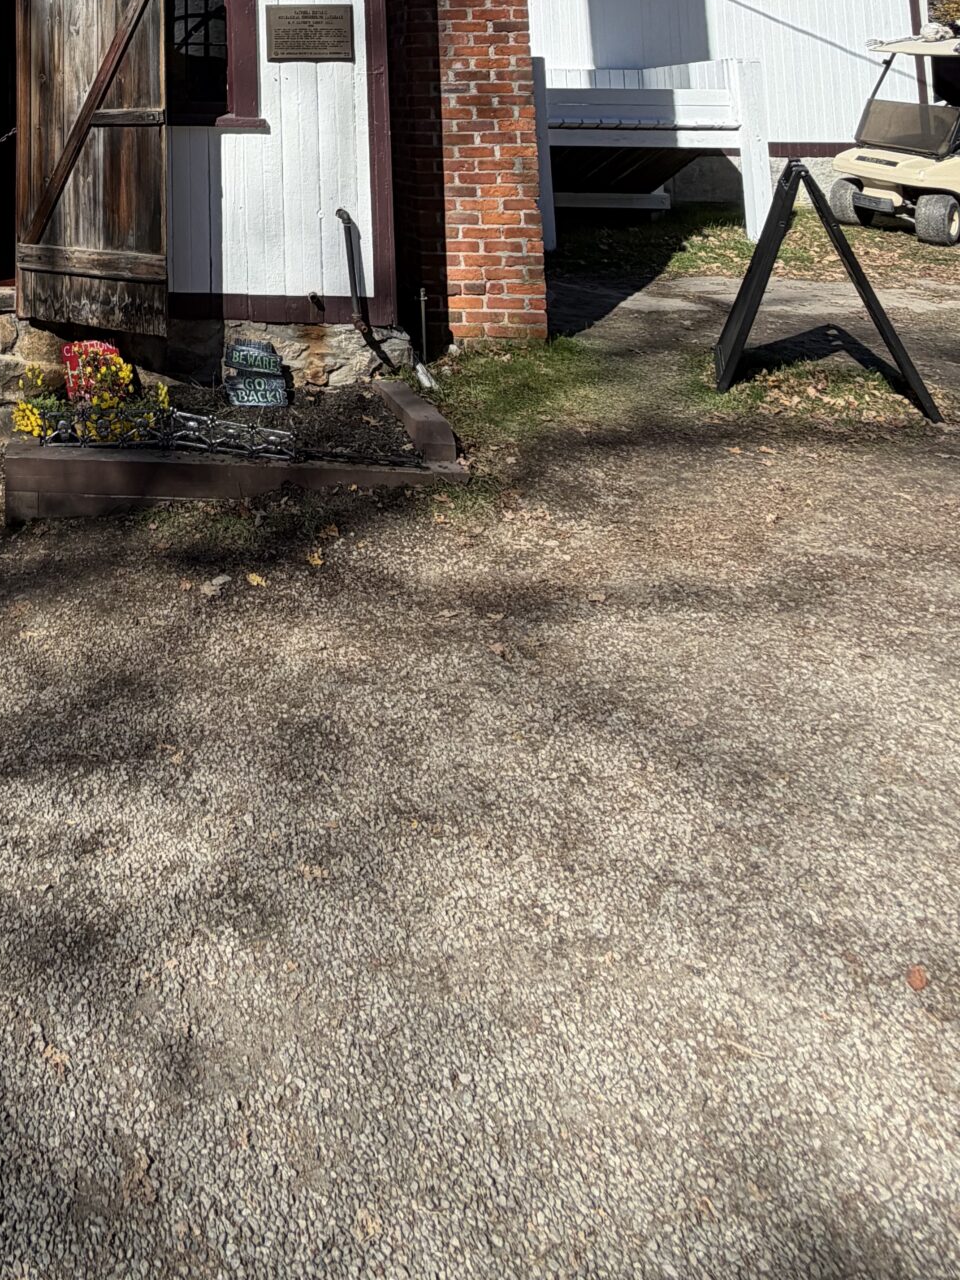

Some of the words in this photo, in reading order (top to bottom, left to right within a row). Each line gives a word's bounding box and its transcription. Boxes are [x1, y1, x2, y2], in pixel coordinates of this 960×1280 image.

[232, 350, 278, 372] BEWARE
[245, 378, 265, 390] GO
[237, 390, 281, 402] BACK!
